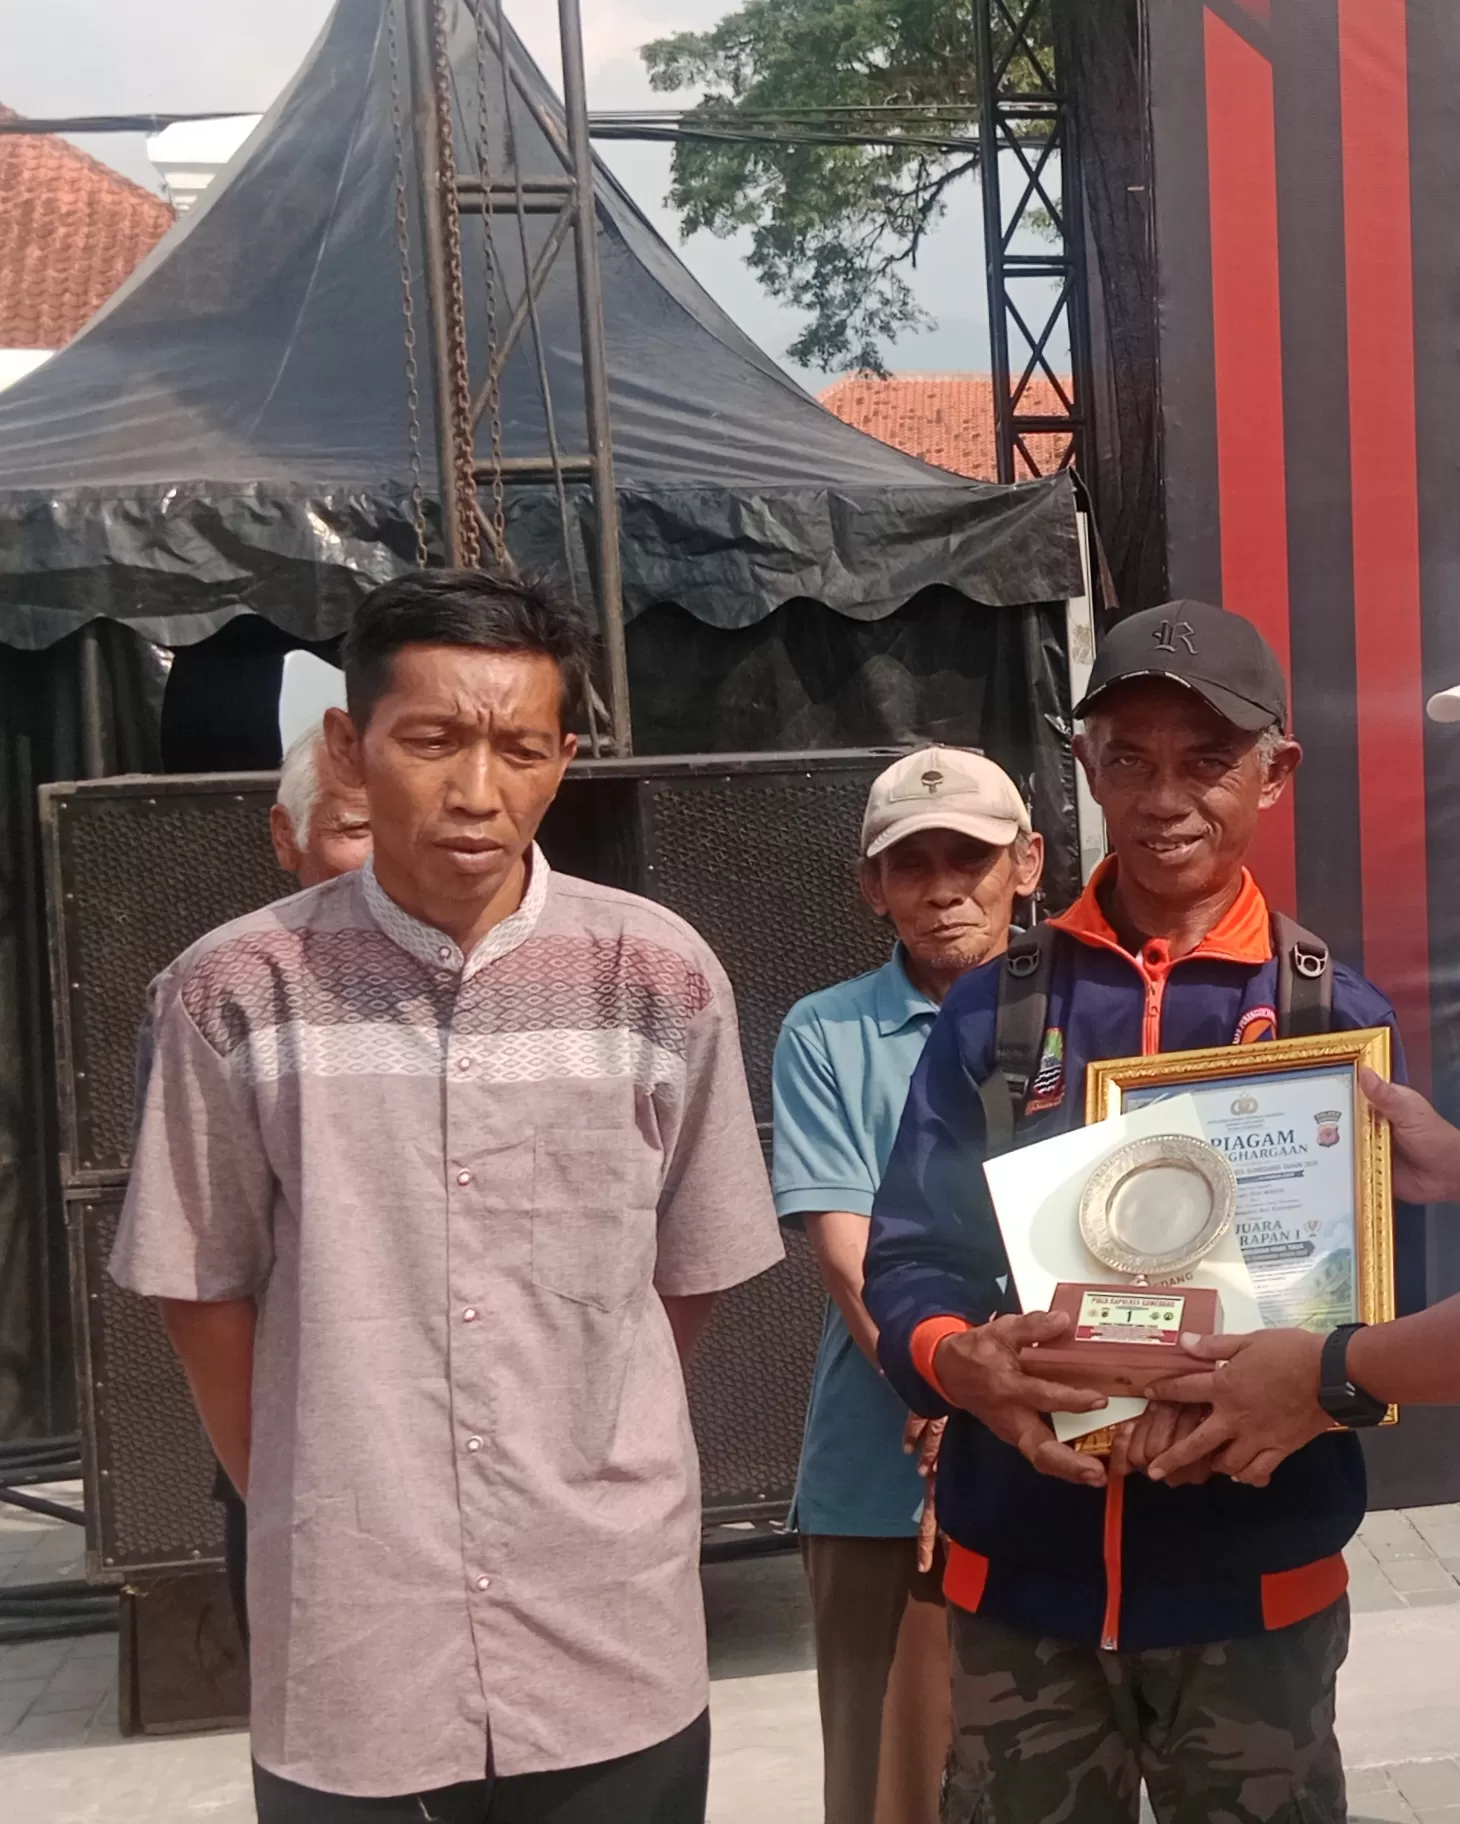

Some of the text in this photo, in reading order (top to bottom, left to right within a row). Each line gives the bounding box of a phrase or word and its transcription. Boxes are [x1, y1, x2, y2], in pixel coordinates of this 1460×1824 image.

[1210, 1129, 1295, 1151] PIAGAM
[1225, 1144, 1308, 1163] GHARGAAN
[1235, 1220, 1282, 1235] JUARA
[1240, 1230, 1290, 1246] RAPAN
[1160, 1271, 1193, 1288] DANG
[1127, 1310, 1132, 1322] 1
